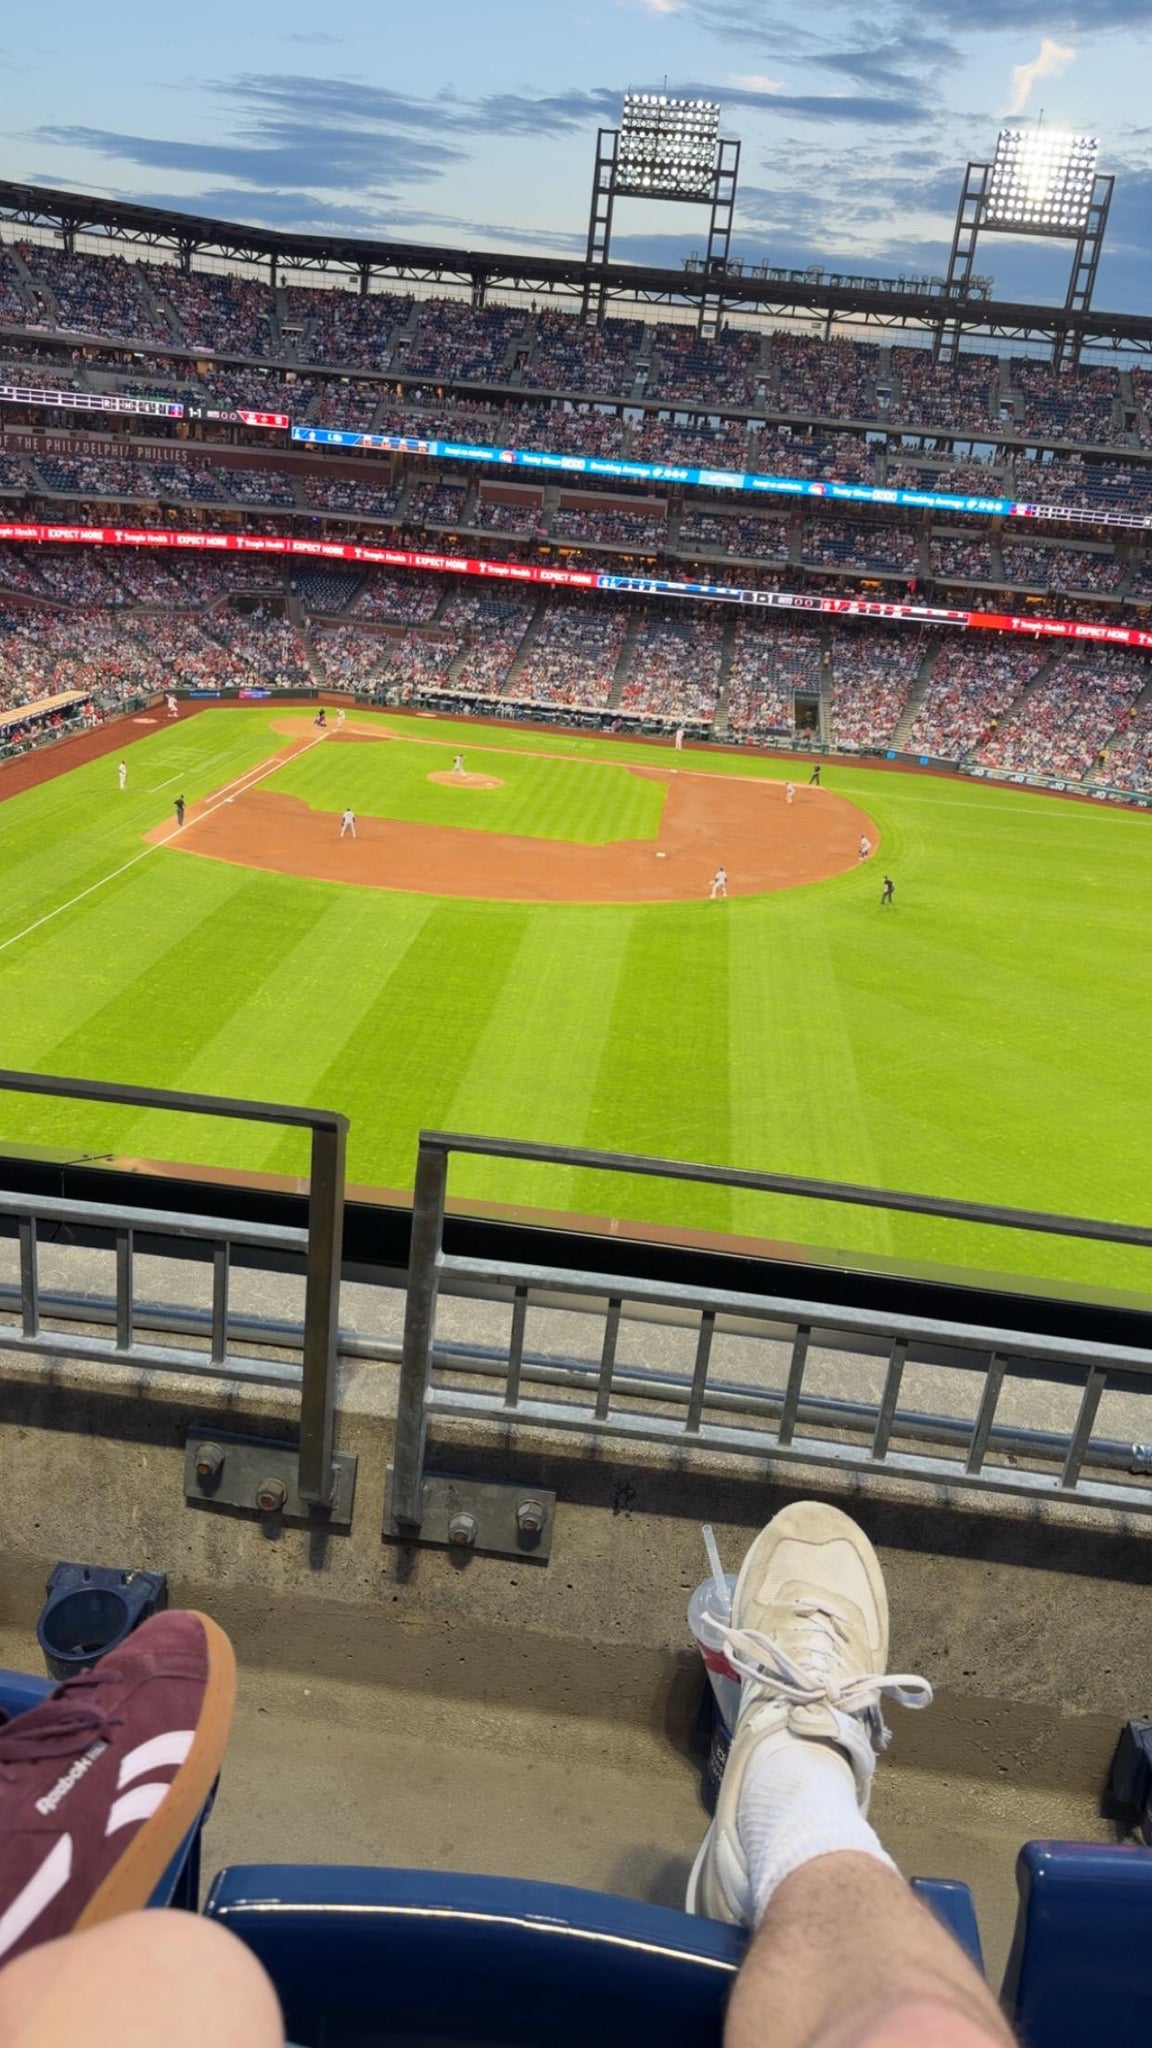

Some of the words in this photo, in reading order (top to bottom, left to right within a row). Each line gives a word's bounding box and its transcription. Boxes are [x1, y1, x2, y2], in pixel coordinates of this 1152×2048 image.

[17, 436, 39, 450] THE
[137, 447, 188, 461] PHILLIES
[48, 529, 79, 540] EXPECT
[80, 530, 104, 540] MORE
[177, 535, 206, 545] EXPECT
[206, 537, 228, 547] MORE
[293, 541, 321, 552] EXPECT
[321, 545, 344, 555] MORE
[415, 555, 445, 569] EXPECT
[445, 559, 467, 571] MORE
[540, 570, 569, 583] EXPECT
[570, 573, 592, 585] MORE
[1075, 625, 1106, 637] EXPECT
[1106, 629, 1130, 639] MORE
[34, 1756, 93, 1816] Reebok
